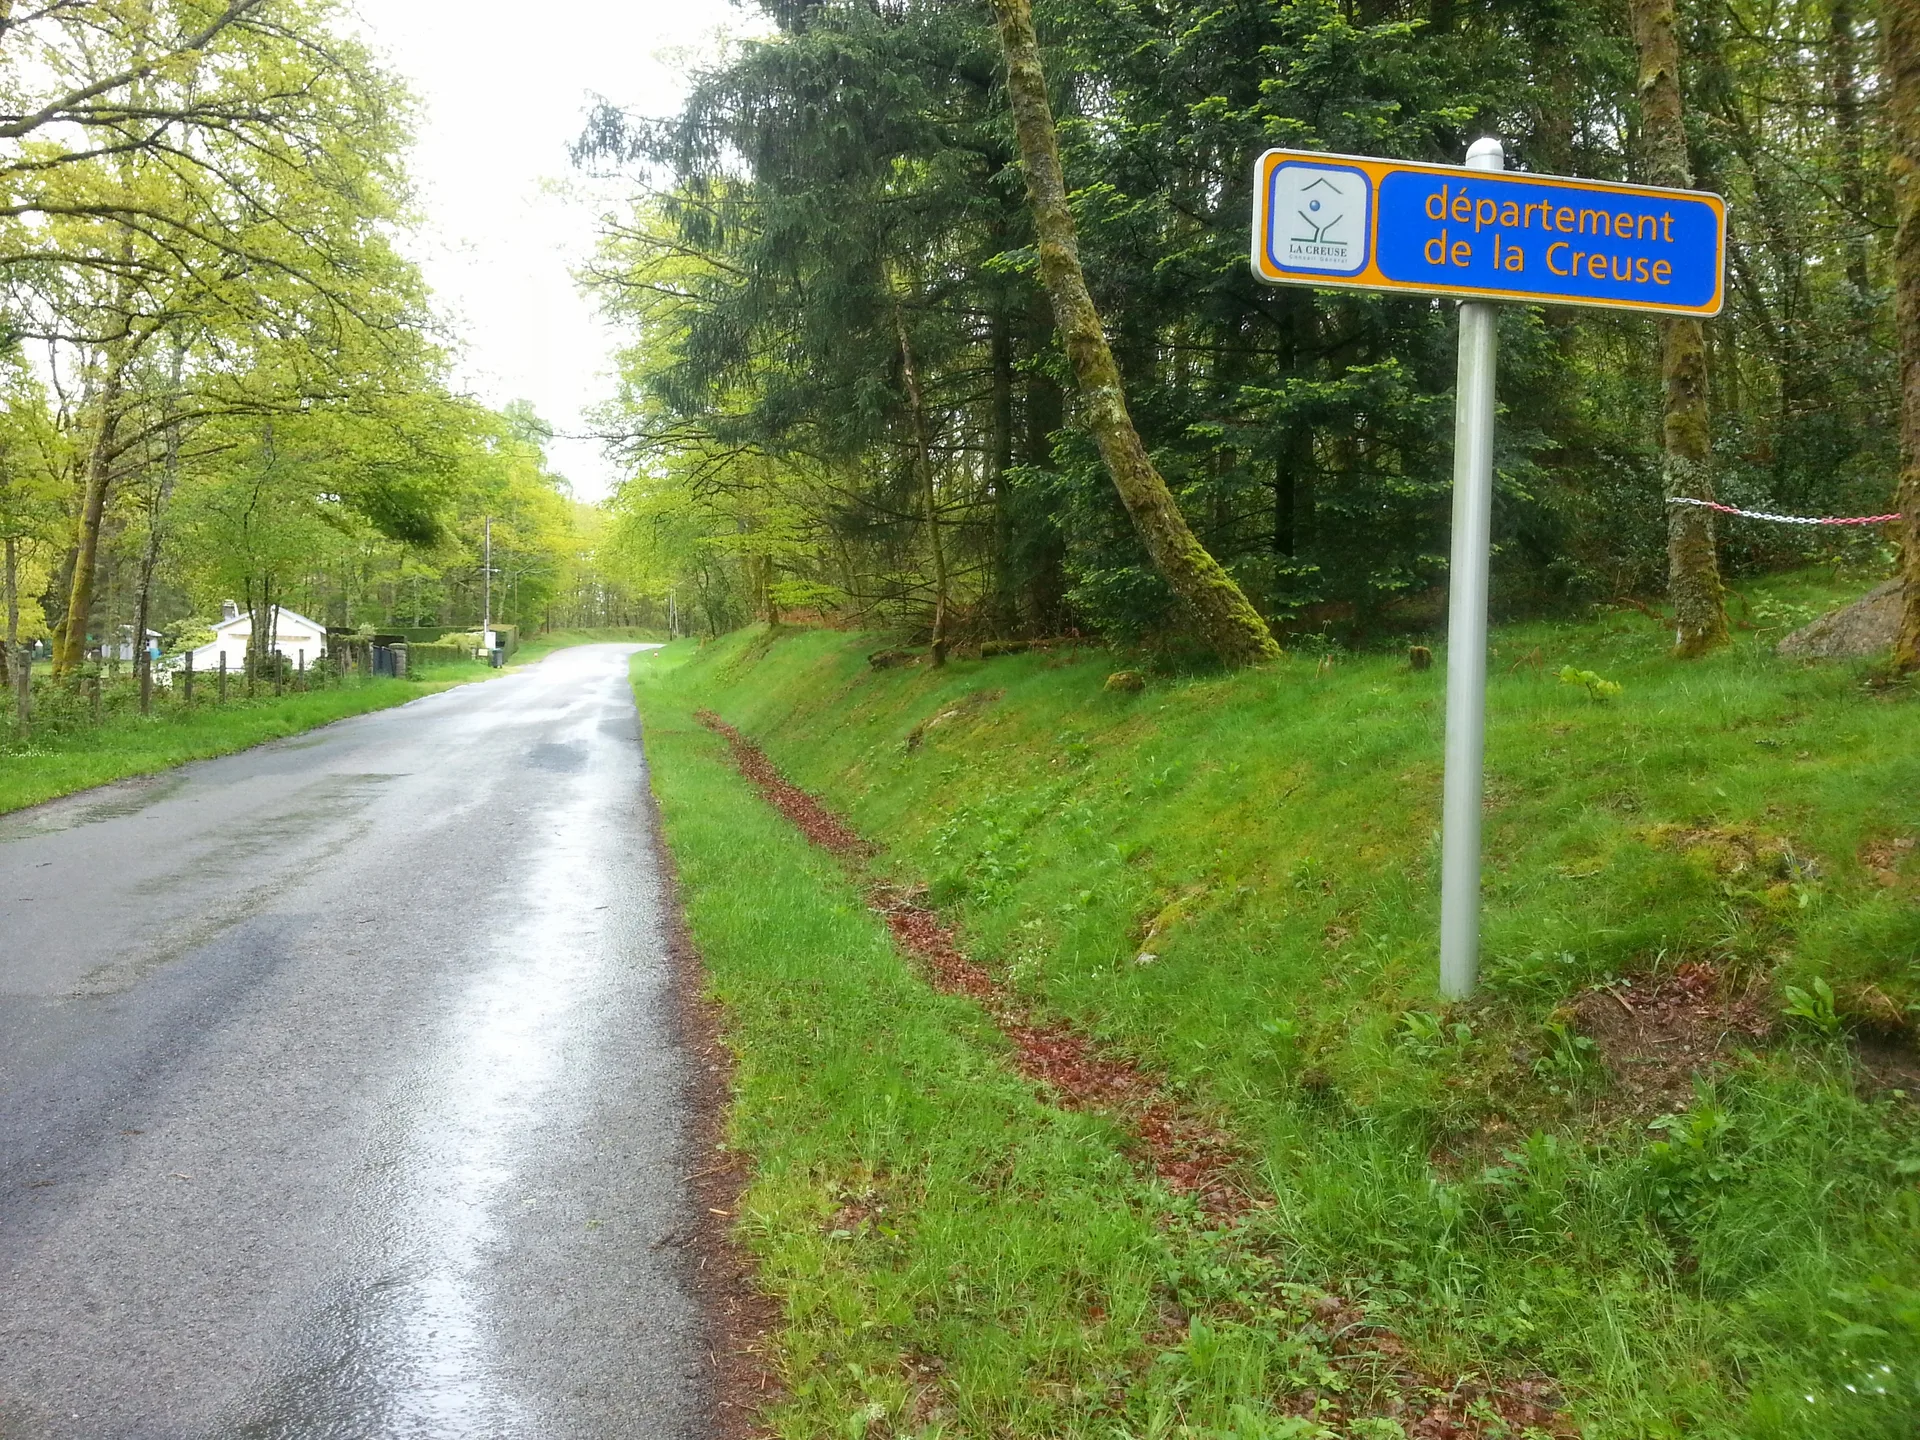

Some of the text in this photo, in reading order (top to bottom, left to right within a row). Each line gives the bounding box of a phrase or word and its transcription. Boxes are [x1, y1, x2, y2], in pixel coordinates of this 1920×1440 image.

[1425, 185, 1675, 242] département
[1289, 244, 1347, 257] LA CREUSE
[1425, 230, 1672, 285] de la Creuse
